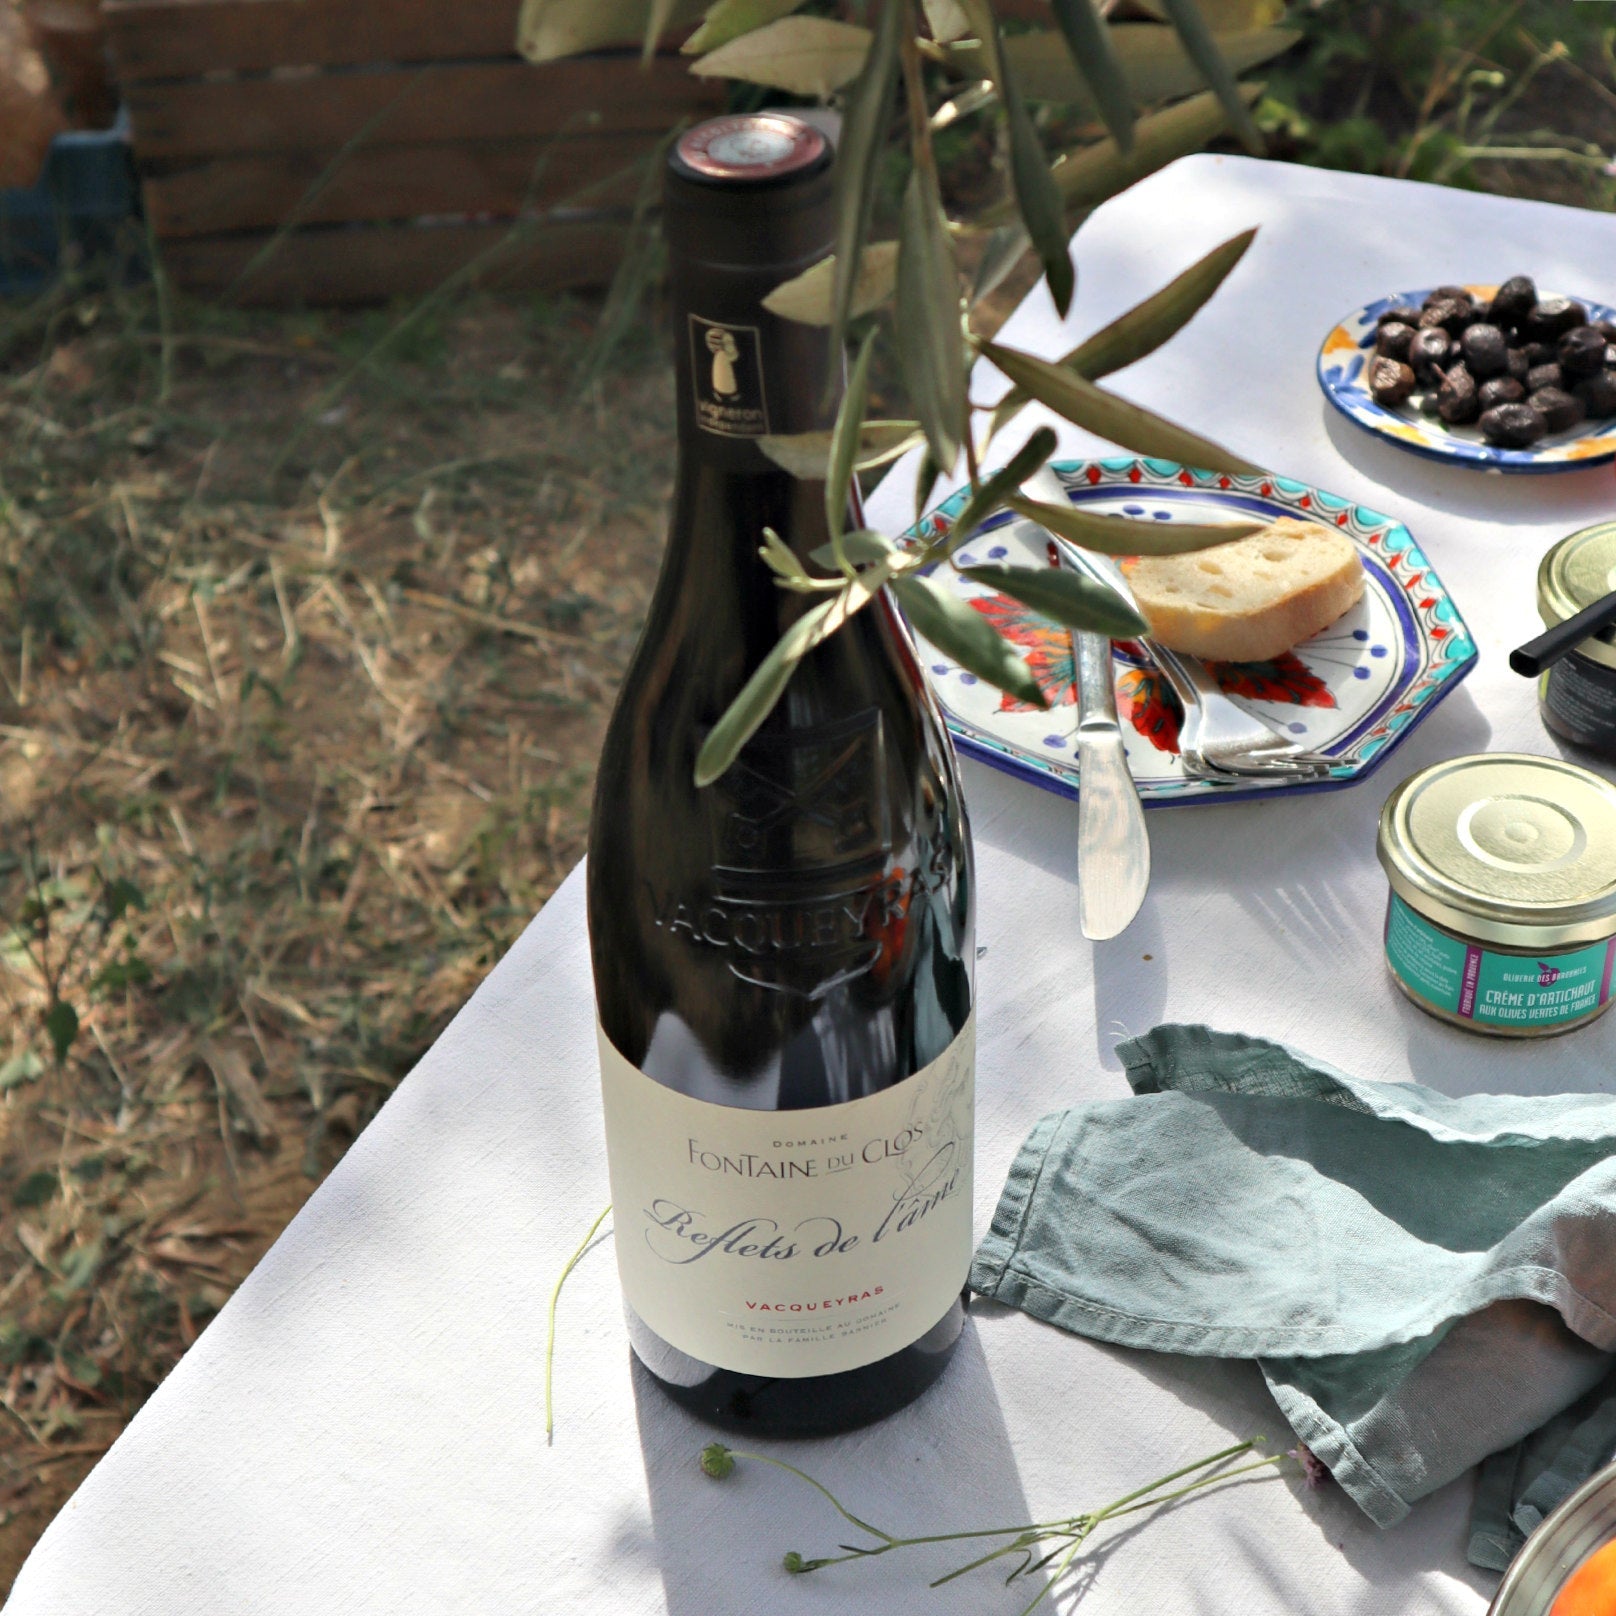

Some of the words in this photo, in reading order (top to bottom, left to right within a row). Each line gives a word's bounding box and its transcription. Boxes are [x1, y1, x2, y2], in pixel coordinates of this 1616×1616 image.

[1537, 973, 1550, 983] DES
[1527, 980, 1596, 1007] D'ARTICHAUT
[1479, 1004, 1497, 1017] AUX
[1498, 1008, 1527, 1020] OLIVES
[1529, 1004, 1558, 1019] VERTES
[1559, 1003, 1569, 1015] DE
[1570, 994, 1596, 1012] FRANCE
[688, 1138, 818, 1178] FONTAINE
[827, 1153, 854, 1169] DU
[862, 1121, 923, 1164] CLOS
[773, 1133, 848, 1148] DOMAINE
[643, 1199, 800, 1265] Reflets
[795, 1217, 860, 1258] de
[745, 1286, 884, 1312] VACQUEYRAS
[770, 1326, 833, 1335] BOUTEILLE
[837, 1321, 851, 1329] AU
[855, 1302, 900, 1324] DOMAINE
[742, 1334, 763, 1342] PAR
[788, 1334, 835, 1343] FAMILLE
